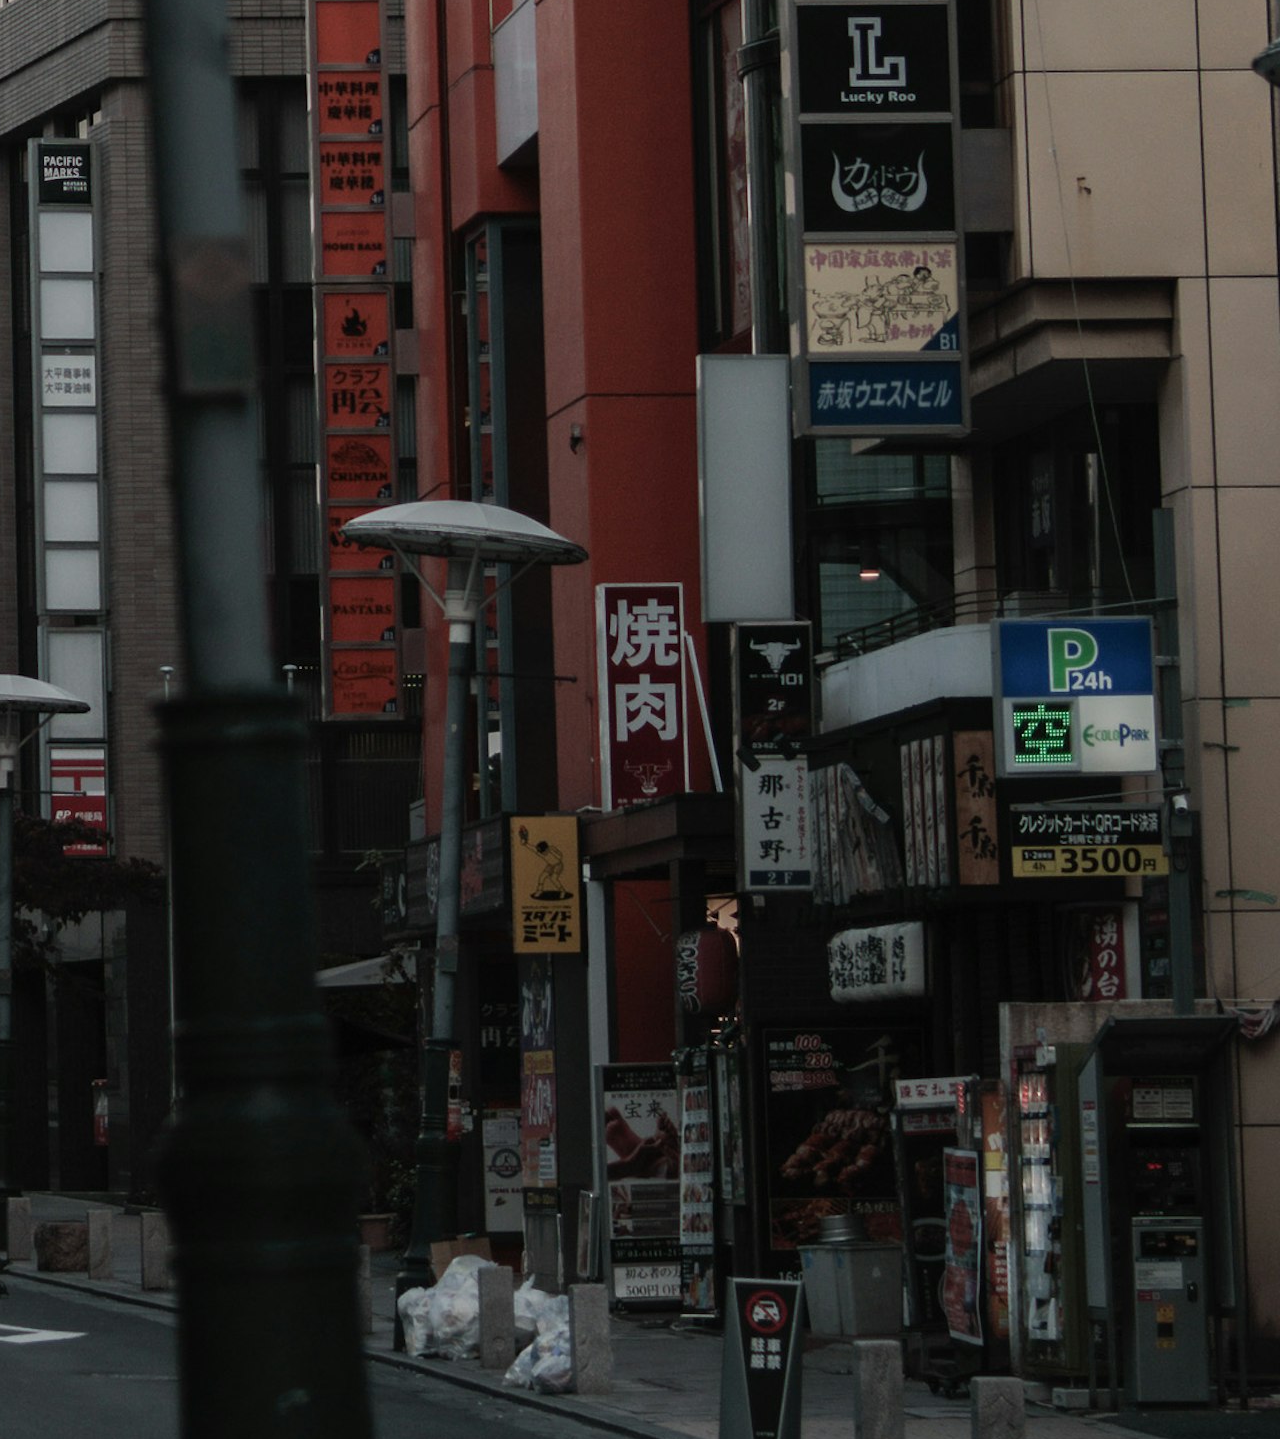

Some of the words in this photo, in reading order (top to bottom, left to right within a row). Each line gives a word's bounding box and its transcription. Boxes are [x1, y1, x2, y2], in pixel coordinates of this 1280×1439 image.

[847, 16, 908, 88] L
[319, 81, 379, 96] 中華料理
[840, 91, 884, 105] Lucky
[887, 91, 917, 102] Roo
[43, 155, 83, 167] PACIFIC
[320, 151, 381, 167] 中華料理
[43, 167, 80, 179] MARKS
[843, 156, 919, 192] カイドウ
[324, 242, 354, 251] HOME
[356, 242, 383, 251] BASE
[939, 332, 957, 351] B1
[332, 368, 382, 385] クラブ
[331, 388, 384, 415] 再会
[817, 378, 952, 411] 赤坂ウエストビル
[1047, 627, 1099, 693] P
[609, 597, 681, 743] 焼肉
[780, 672, 804, 686] 101
[1071, 671, 1113, 691] 24h
[768, 698, 786, 711] 2F
[1013, 703, 1073, 764] 空
[759, 773, 785, 863] 那古野
[768, 871, 793, 885] 2F
[521, 910, 572, 922] スタンド
[523, 925, 573, 943] ミート
[625, 1099, 664, 1119] 宝来
